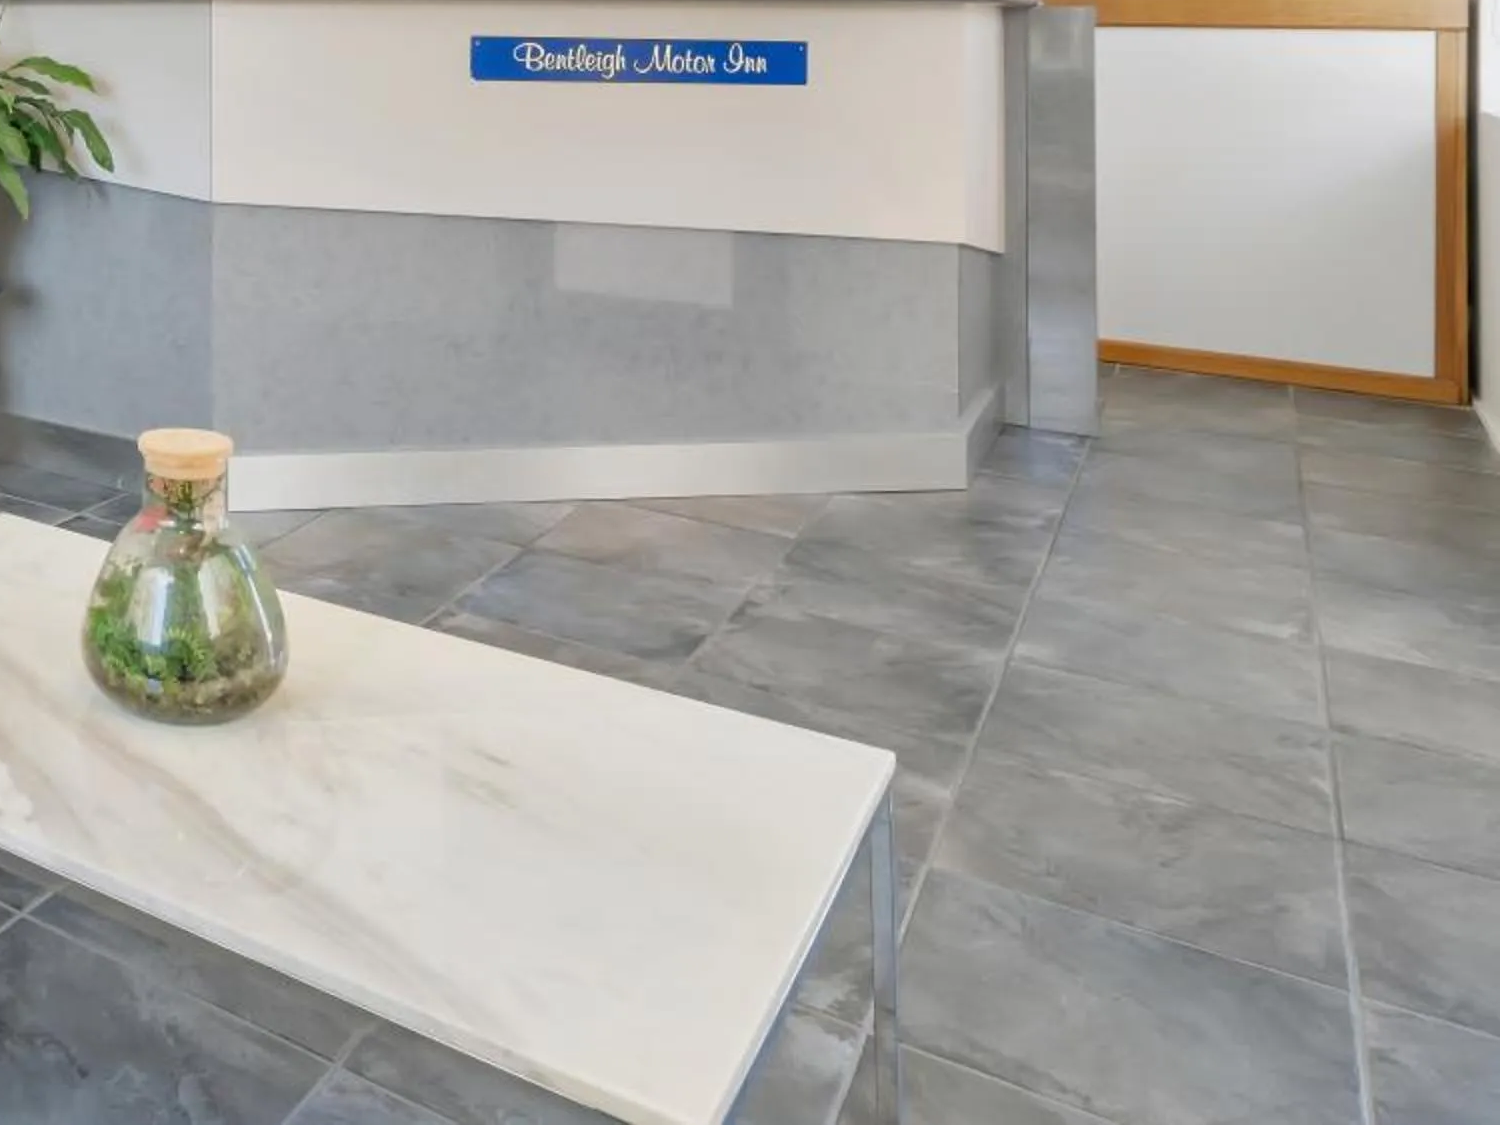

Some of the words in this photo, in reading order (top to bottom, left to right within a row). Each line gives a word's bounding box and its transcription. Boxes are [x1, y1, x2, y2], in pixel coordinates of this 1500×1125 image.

[513, 42, 625, 79] Bentleigh
[634, 43, 715, 73] Motor
[724, 42, 767, 73] Inn
